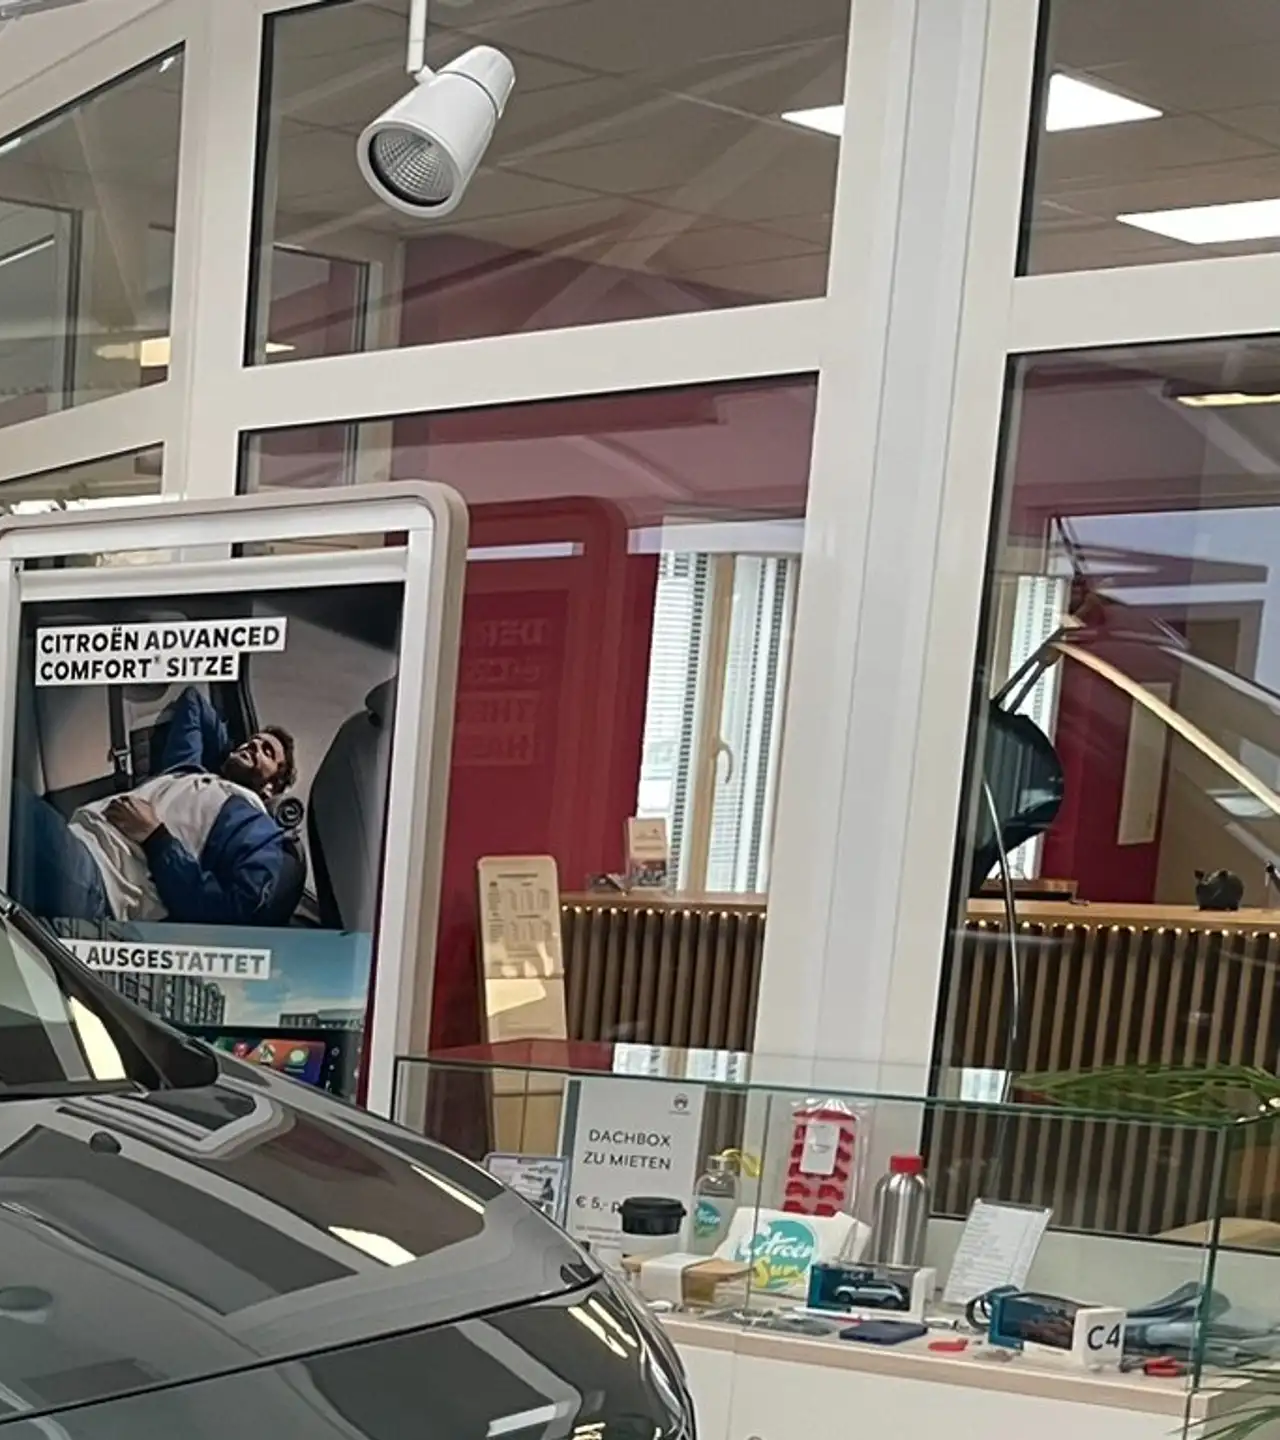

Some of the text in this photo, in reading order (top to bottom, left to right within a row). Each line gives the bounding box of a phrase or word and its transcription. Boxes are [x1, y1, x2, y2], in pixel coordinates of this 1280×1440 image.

[40, 625, 280, 653] CITROËN ADVANCED
[166, 655, 234, 678] SITZE
[86, 947, 265, 974] AUSGESTATTET
[588, 1128, 671, 1147] DACHBOX
[583, 1151, 671, 1170] ZU MIETEN
[575, 1196, 587, 1208] €
[1087, 1322, 1121, 1351] C4
